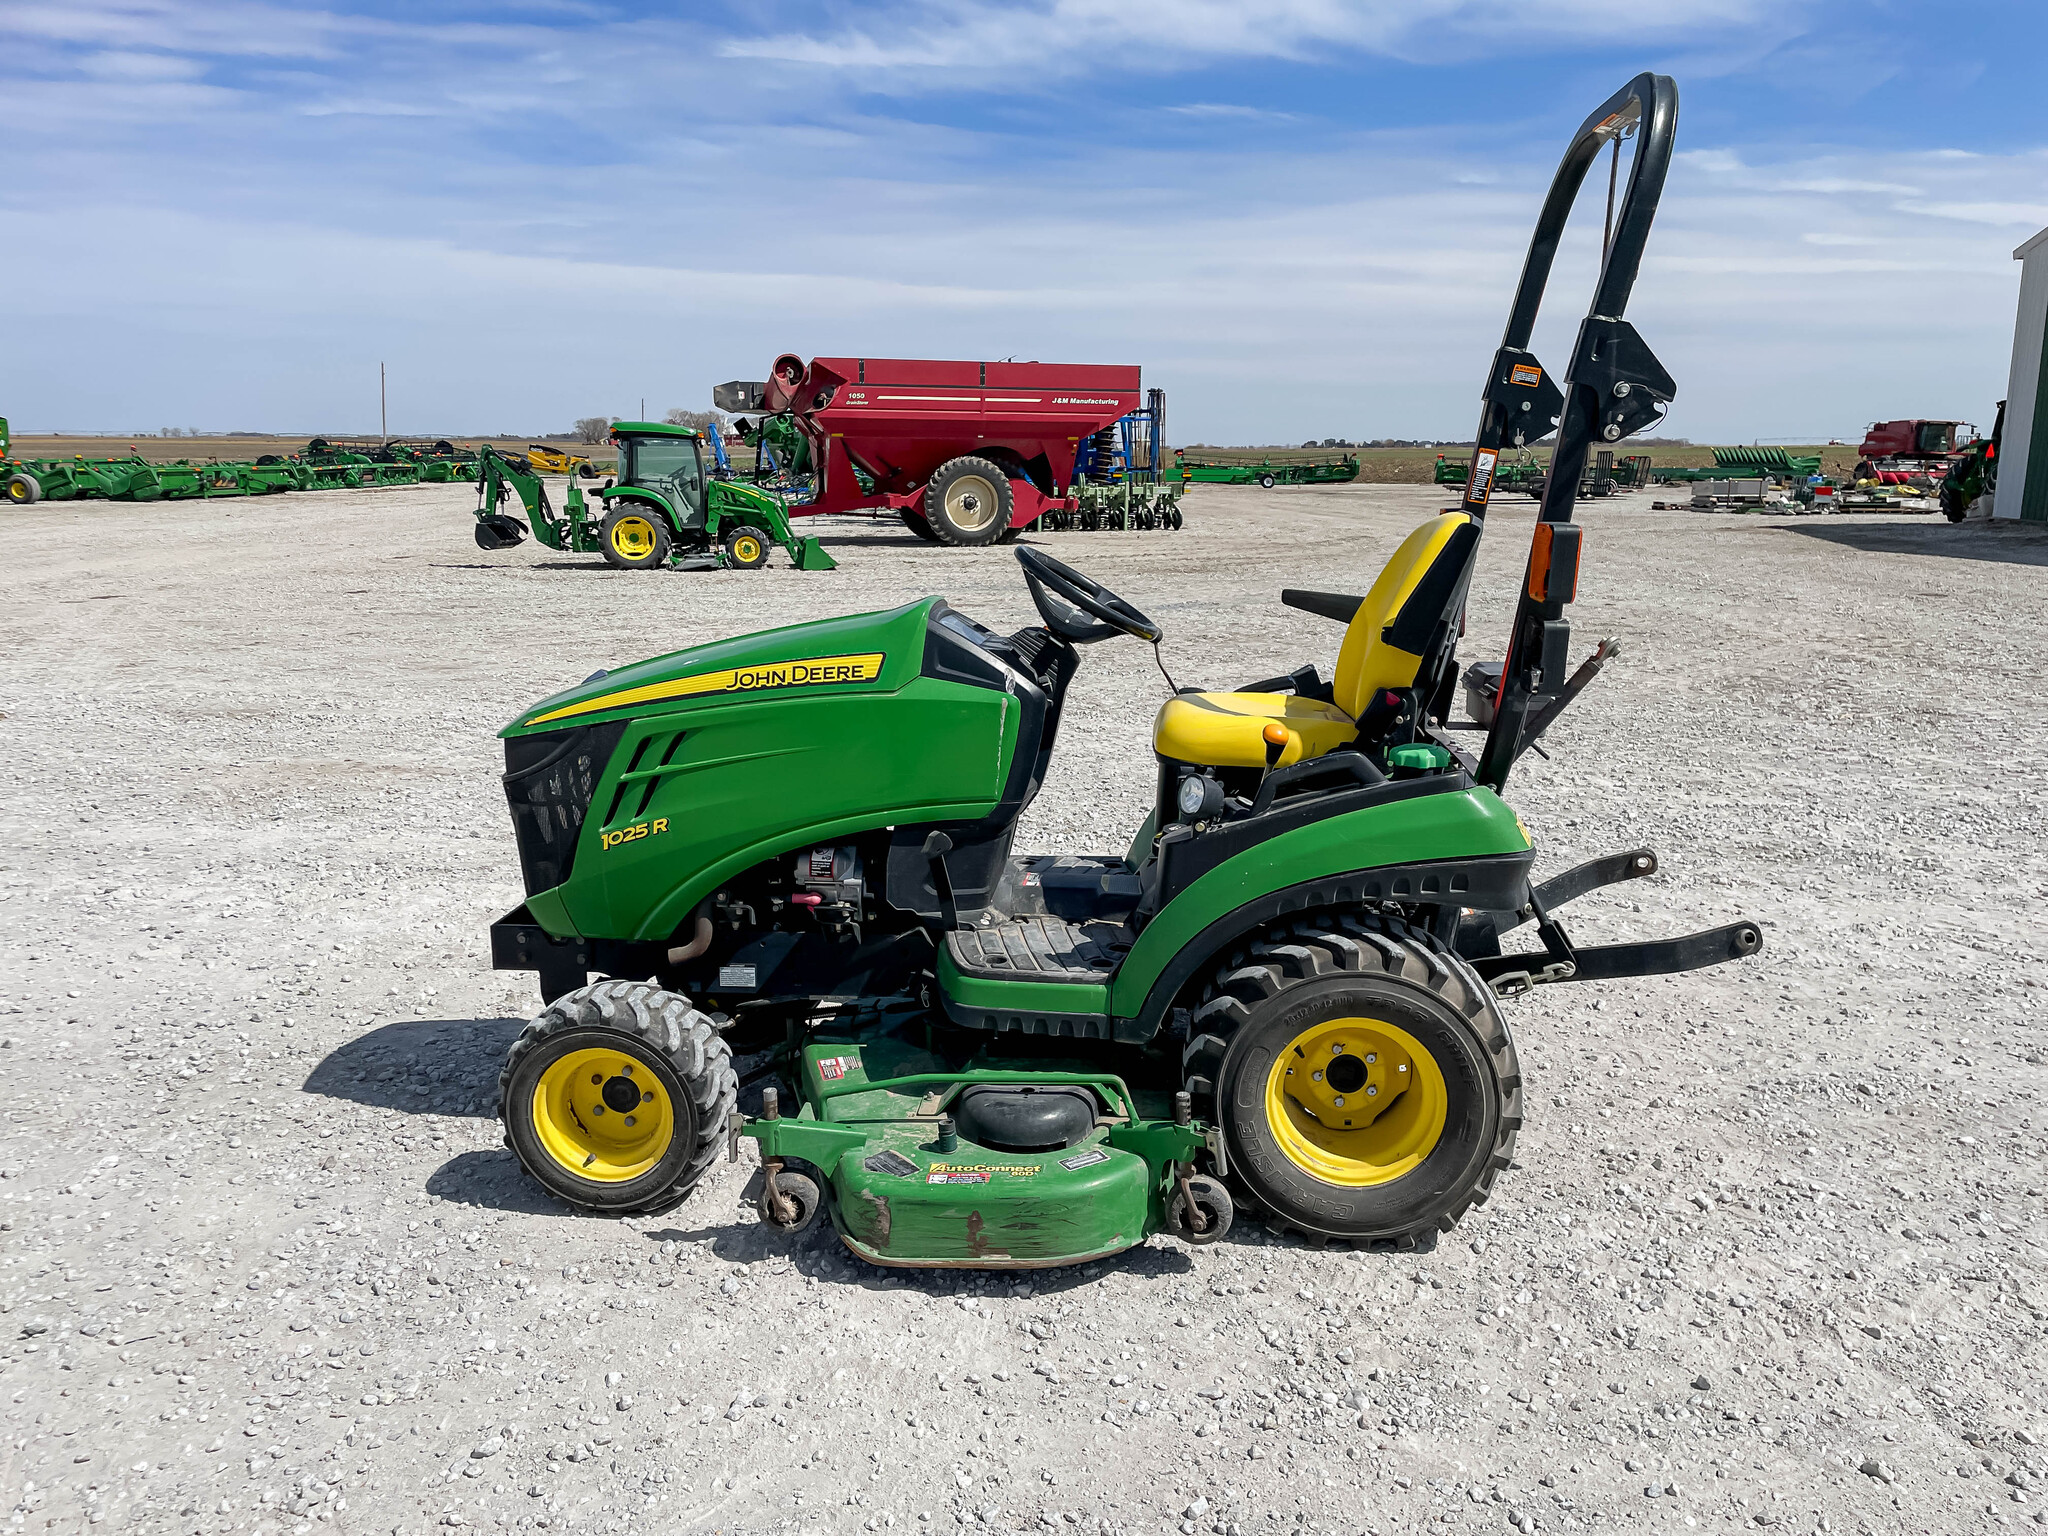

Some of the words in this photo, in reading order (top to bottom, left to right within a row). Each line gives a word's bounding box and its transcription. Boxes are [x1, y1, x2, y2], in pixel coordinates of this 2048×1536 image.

[1069, 397, 1119, 406] Manufacturing
[726, 669, 786, 688] JOHN
[792, 665, 864, 684] DEERE
[601, 823, 649, 851] 1025
[653, 818, 669, 835] R
[929, 1163, 1042, 1173] AutoConnect
[1237, 1120, 1355, 1221] CARLISLE
